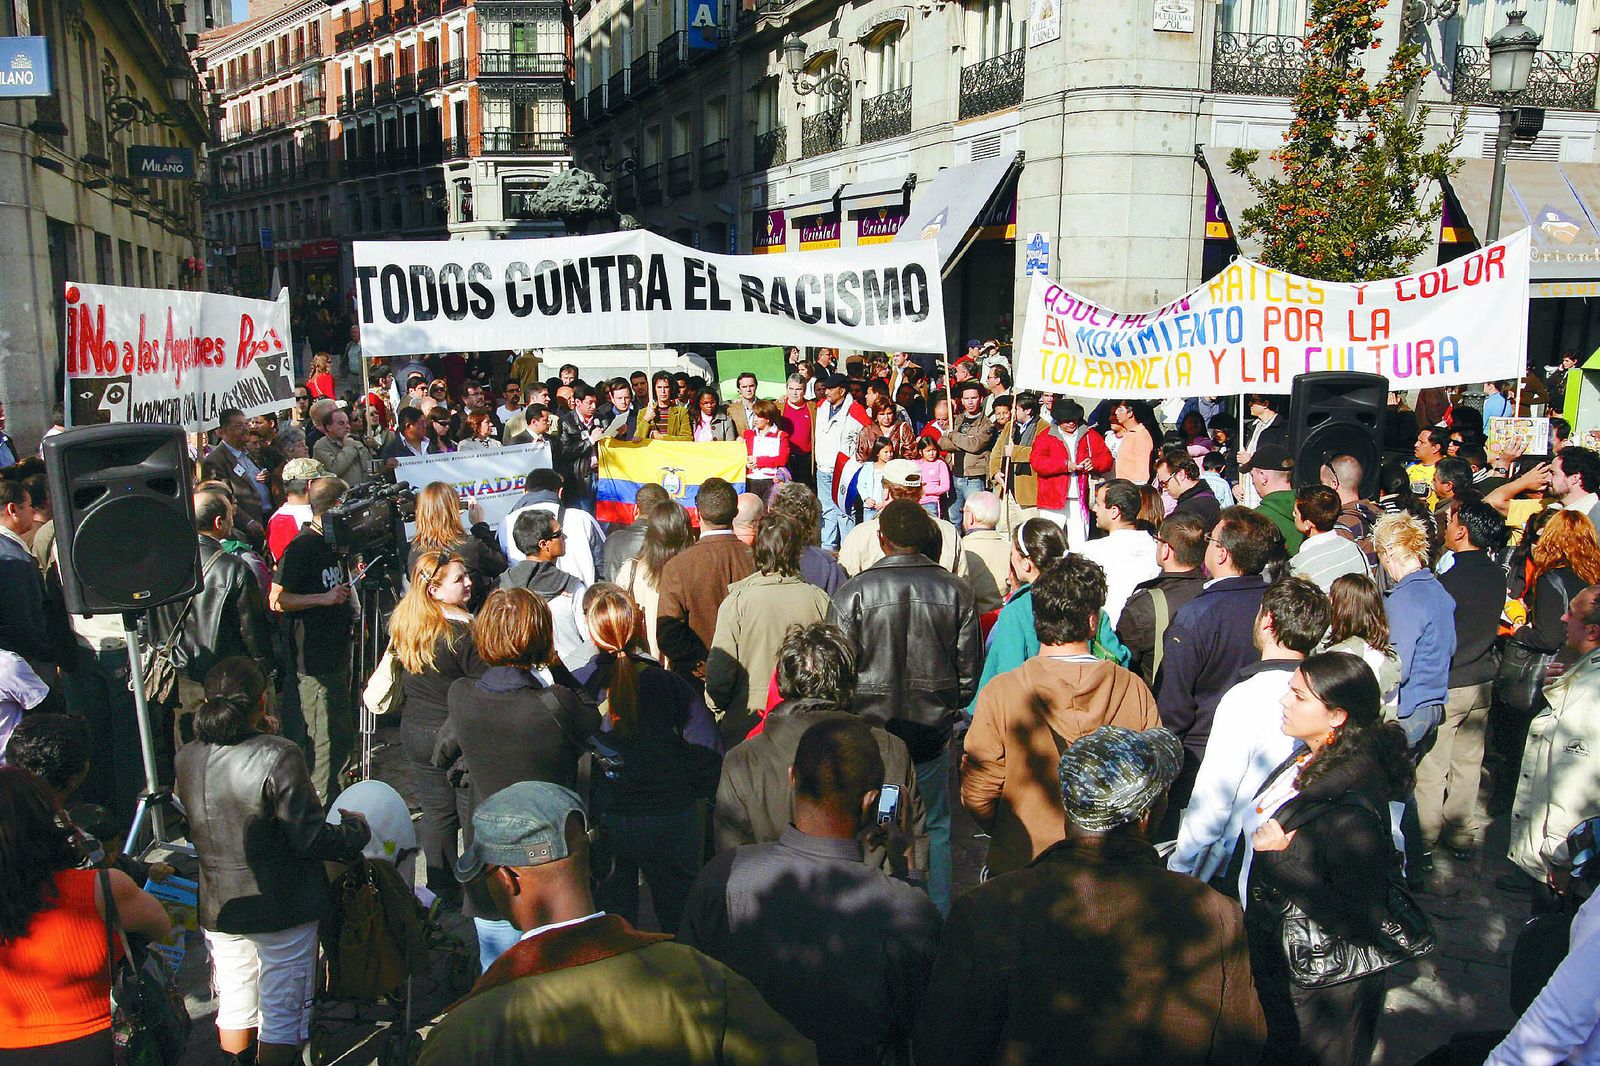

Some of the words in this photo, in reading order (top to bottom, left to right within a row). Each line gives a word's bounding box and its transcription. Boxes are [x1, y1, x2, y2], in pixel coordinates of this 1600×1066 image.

[355, 262, 496, 324] TODOS
[504, 253, 672, 317] CONTRA
[683, 256, 731, 311] EL
[738, 262, 930, 327] RACISMO
[1350, 284, 1369, 305] Y
[1394, 245, 1506, 302] COLOR
[122, 341, 135, 374] a
[137, 313, 159, 376] las
[1042, 314, 1069, 349] EN
[1075, 306, 1243, 358] MOVIMIENTO
[1263, 306, 1323, 343] POR
[1348, 308, 1390, 342] LA
[1039, 348, 1192, 390] TOLERANCIA
[1208, 348, 1227, 385] Y
[1241, 346, 1280, 384] LA
[1304, 336, 1460, 379] CULTURA
[202, 391, 219, 422] LA
